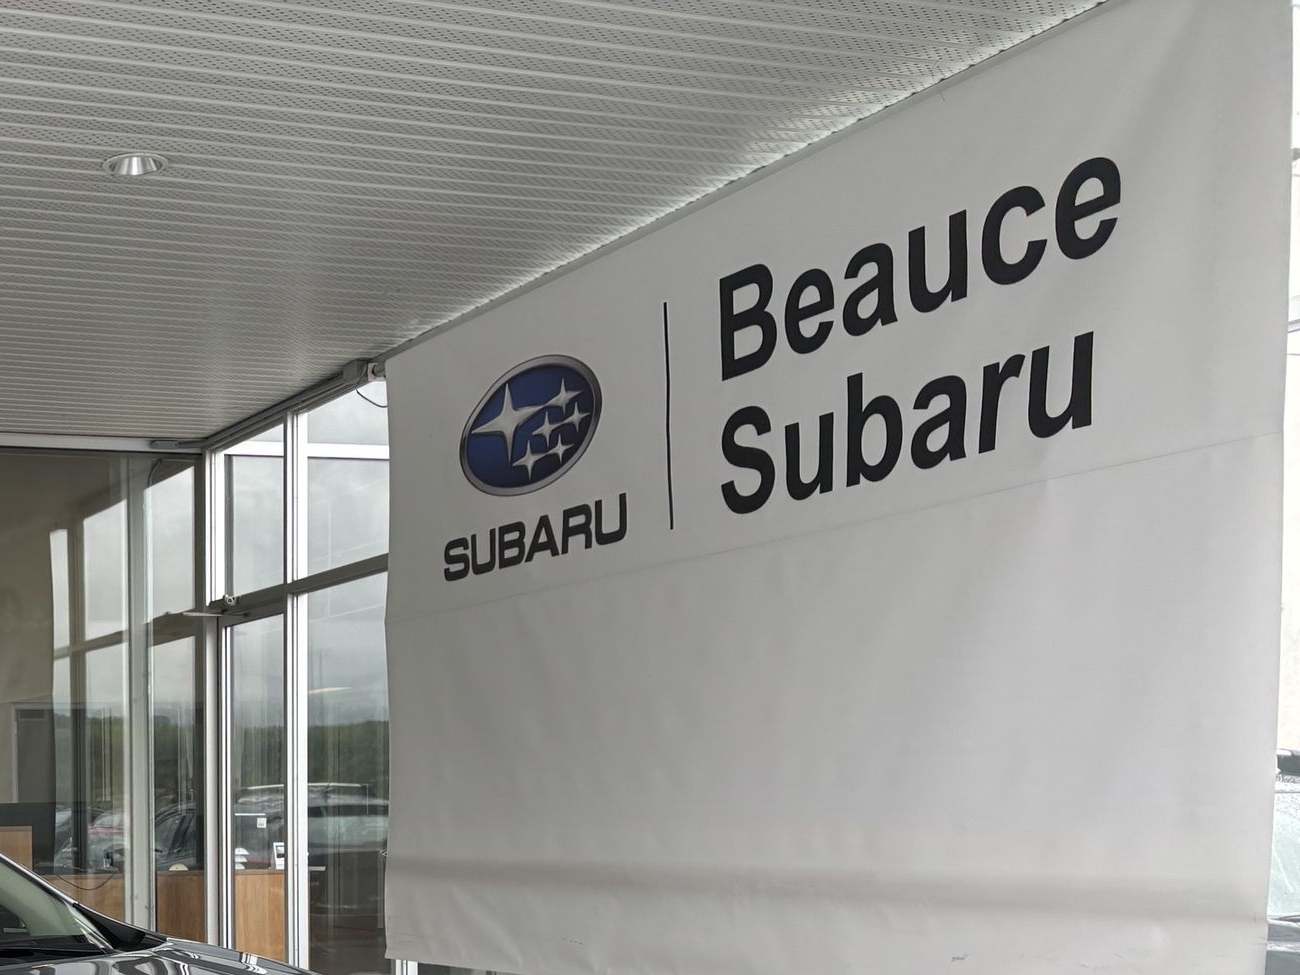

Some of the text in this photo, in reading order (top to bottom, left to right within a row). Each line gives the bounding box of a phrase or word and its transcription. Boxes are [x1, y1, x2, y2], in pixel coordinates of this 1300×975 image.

[719, 156, 1122, 380] Beauce
[720, 330, 1096, 515] Subaru
[443, 492, 628, 582] SUBARU
